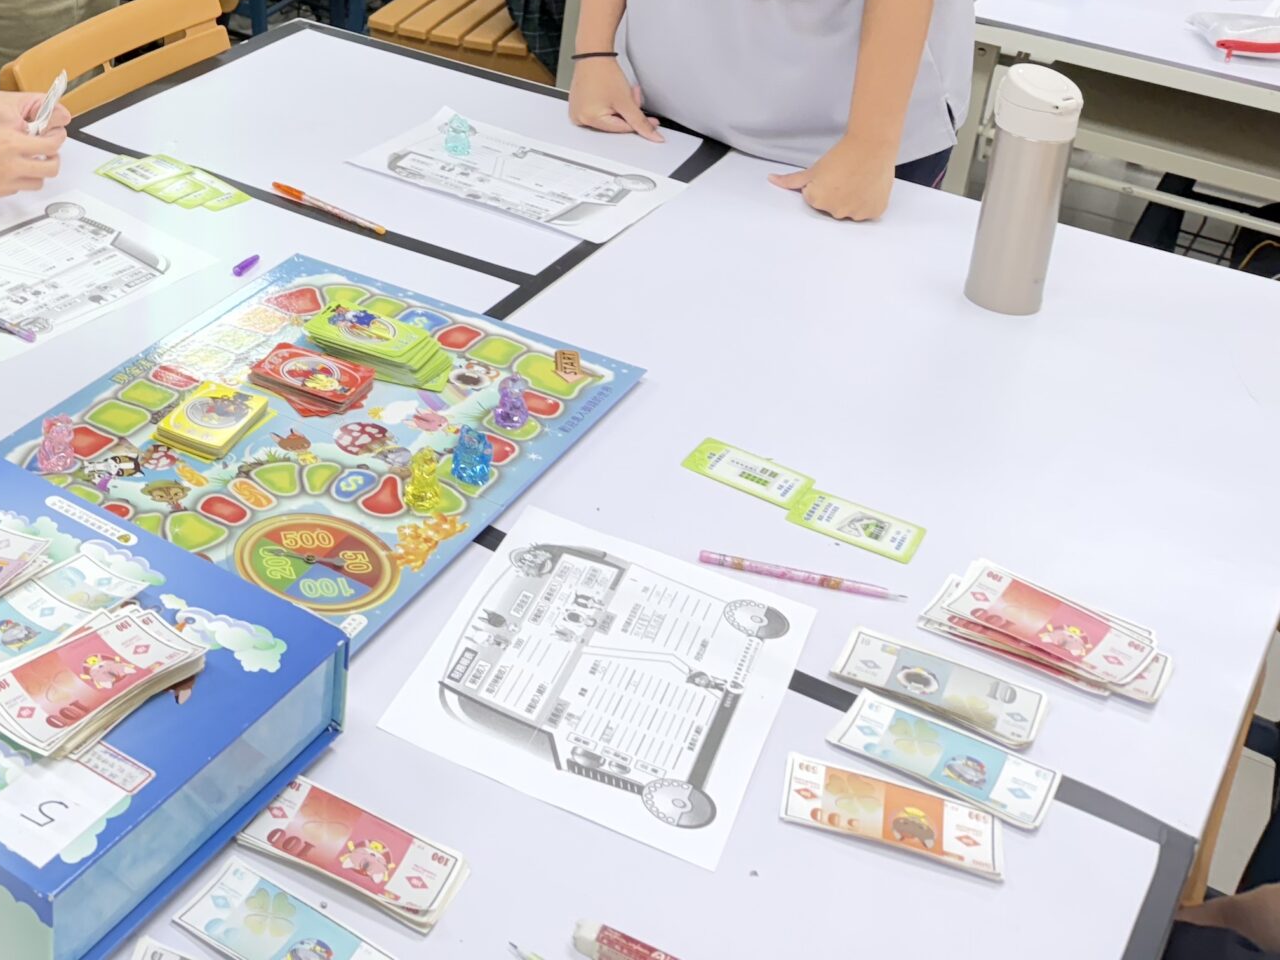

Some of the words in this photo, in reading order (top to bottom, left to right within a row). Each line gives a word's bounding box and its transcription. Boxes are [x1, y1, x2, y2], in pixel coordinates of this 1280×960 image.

[562, 351, 577, 376] START
[280, 530, 335, 549] 500
[259, 546, 297, 579] 200
[339, 550, 373, 573] 50
[299, 577, 355, 598] 100
[986, 681, 1018, 704] 10
[45, 700, 89, 729] 100
[20, 800, 69, 827] 5
[266, 827, 316, 859] 100
